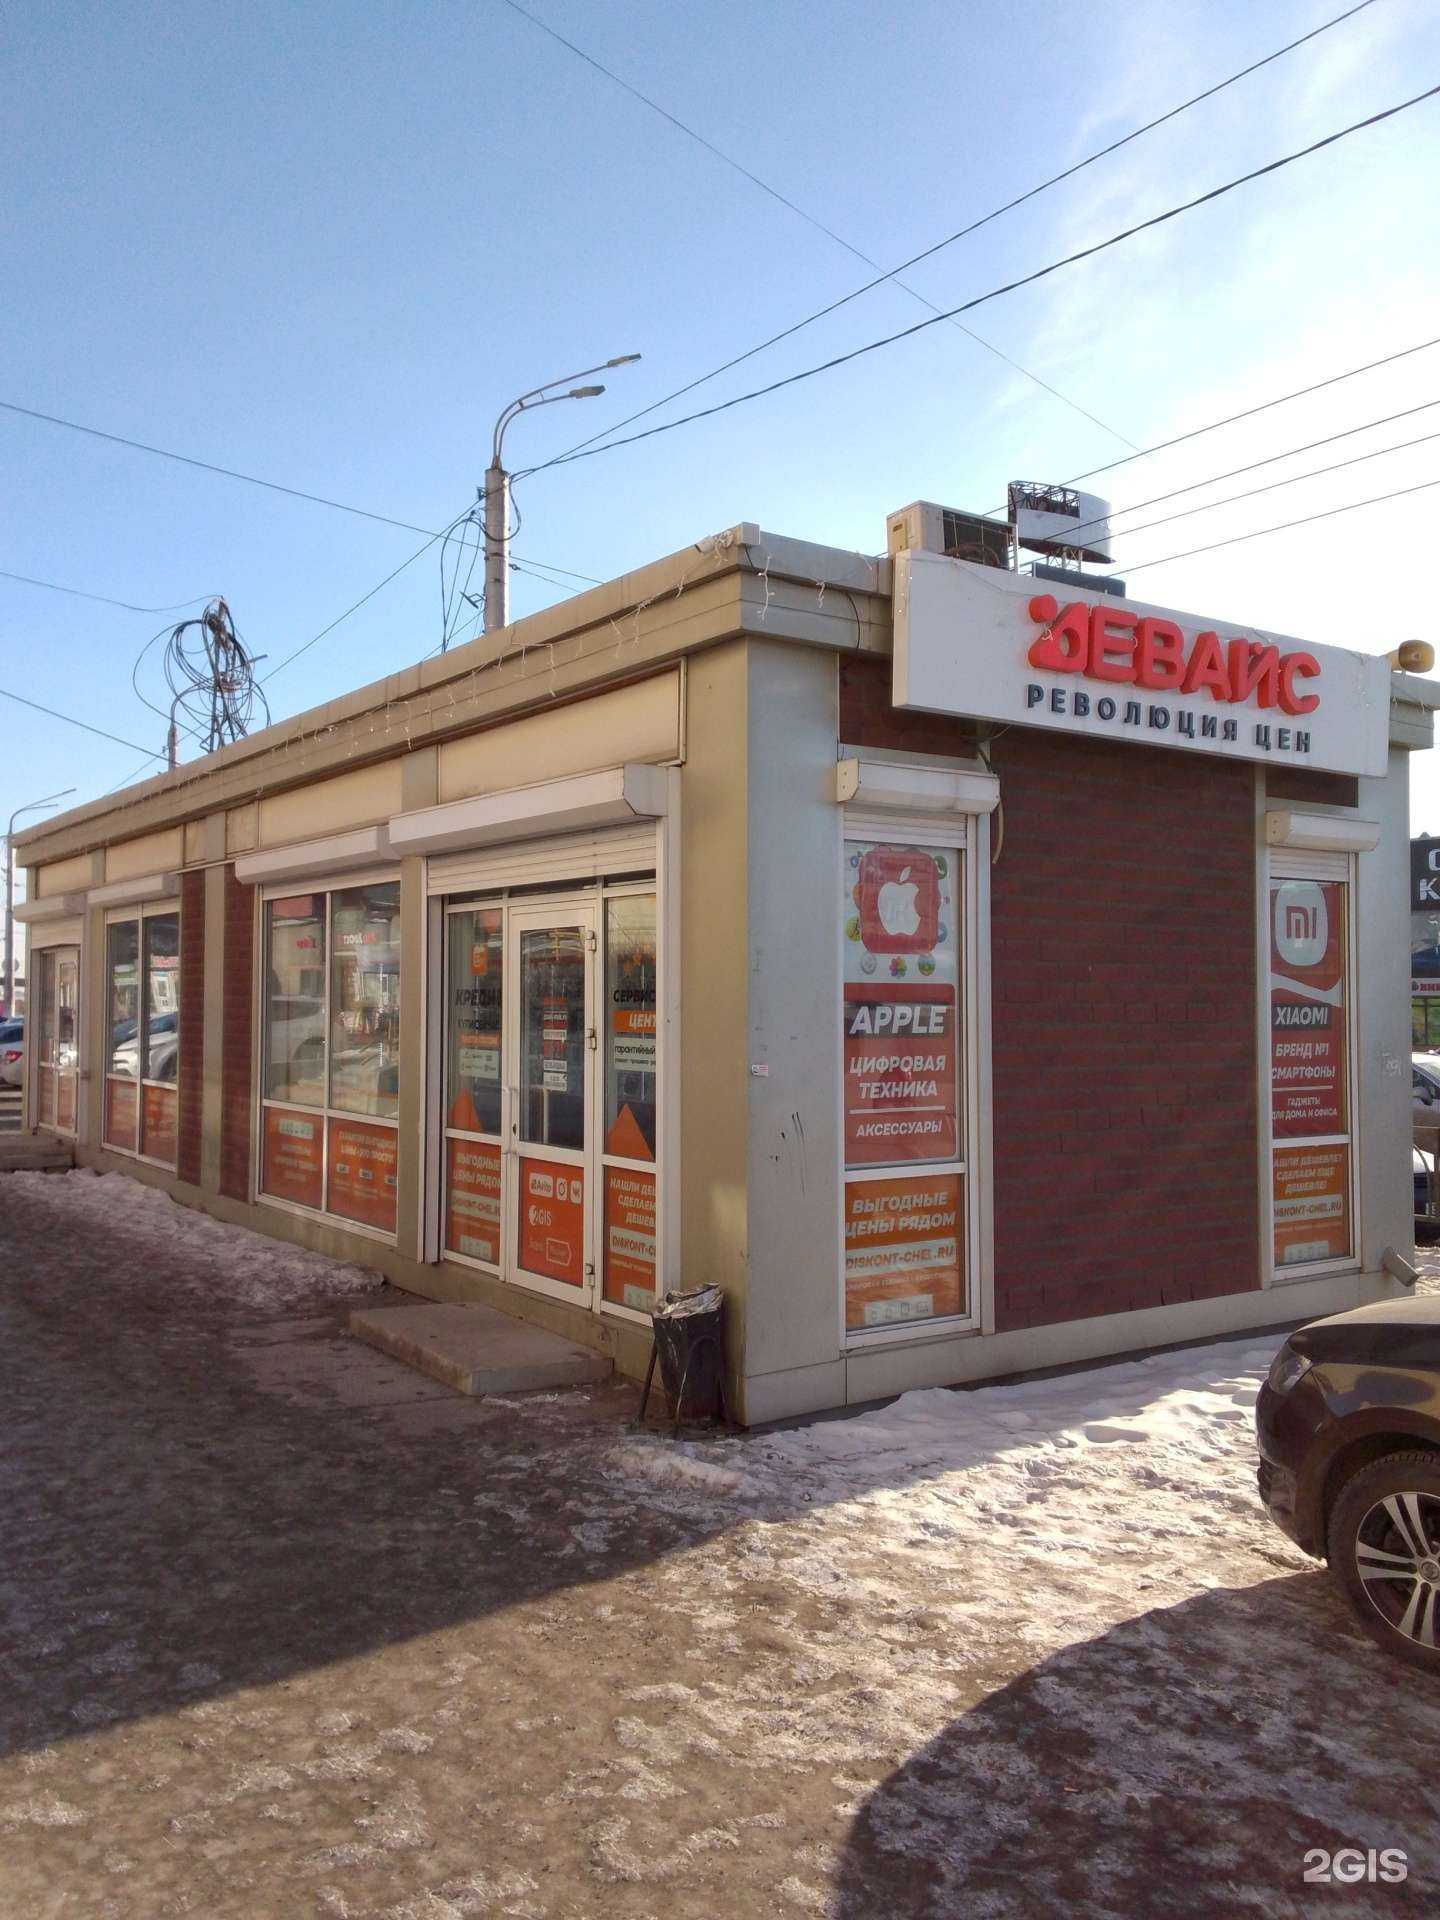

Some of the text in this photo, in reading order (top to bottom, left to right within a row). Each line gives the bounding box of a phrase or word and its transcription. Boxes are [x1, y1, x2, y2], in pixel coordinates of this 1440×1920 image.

[1028, 595, 1321, 715] ДЕВАЙС
[1027, 683, 1311, 753] РЕВОЛЮЦИЯ ЦЕН
[849, 1005, 947, 1034] APPLE
[1275, 1006, 1329, 1025] XIAOMI
[1275, 1043, 1313, 1059] БРЕНД
[849, 1055, 946, 1077] ЦИФРОВАЯ
[859, 1080, 938, 1099] ТЕХНИКА
[856, 1120, 942, 1136] АКСЕССУАРЫ
[852, 1191, 948, 1214] ВЫГОДНЫЕ
[898, 1211, 956, 1231] РЯДОМ
